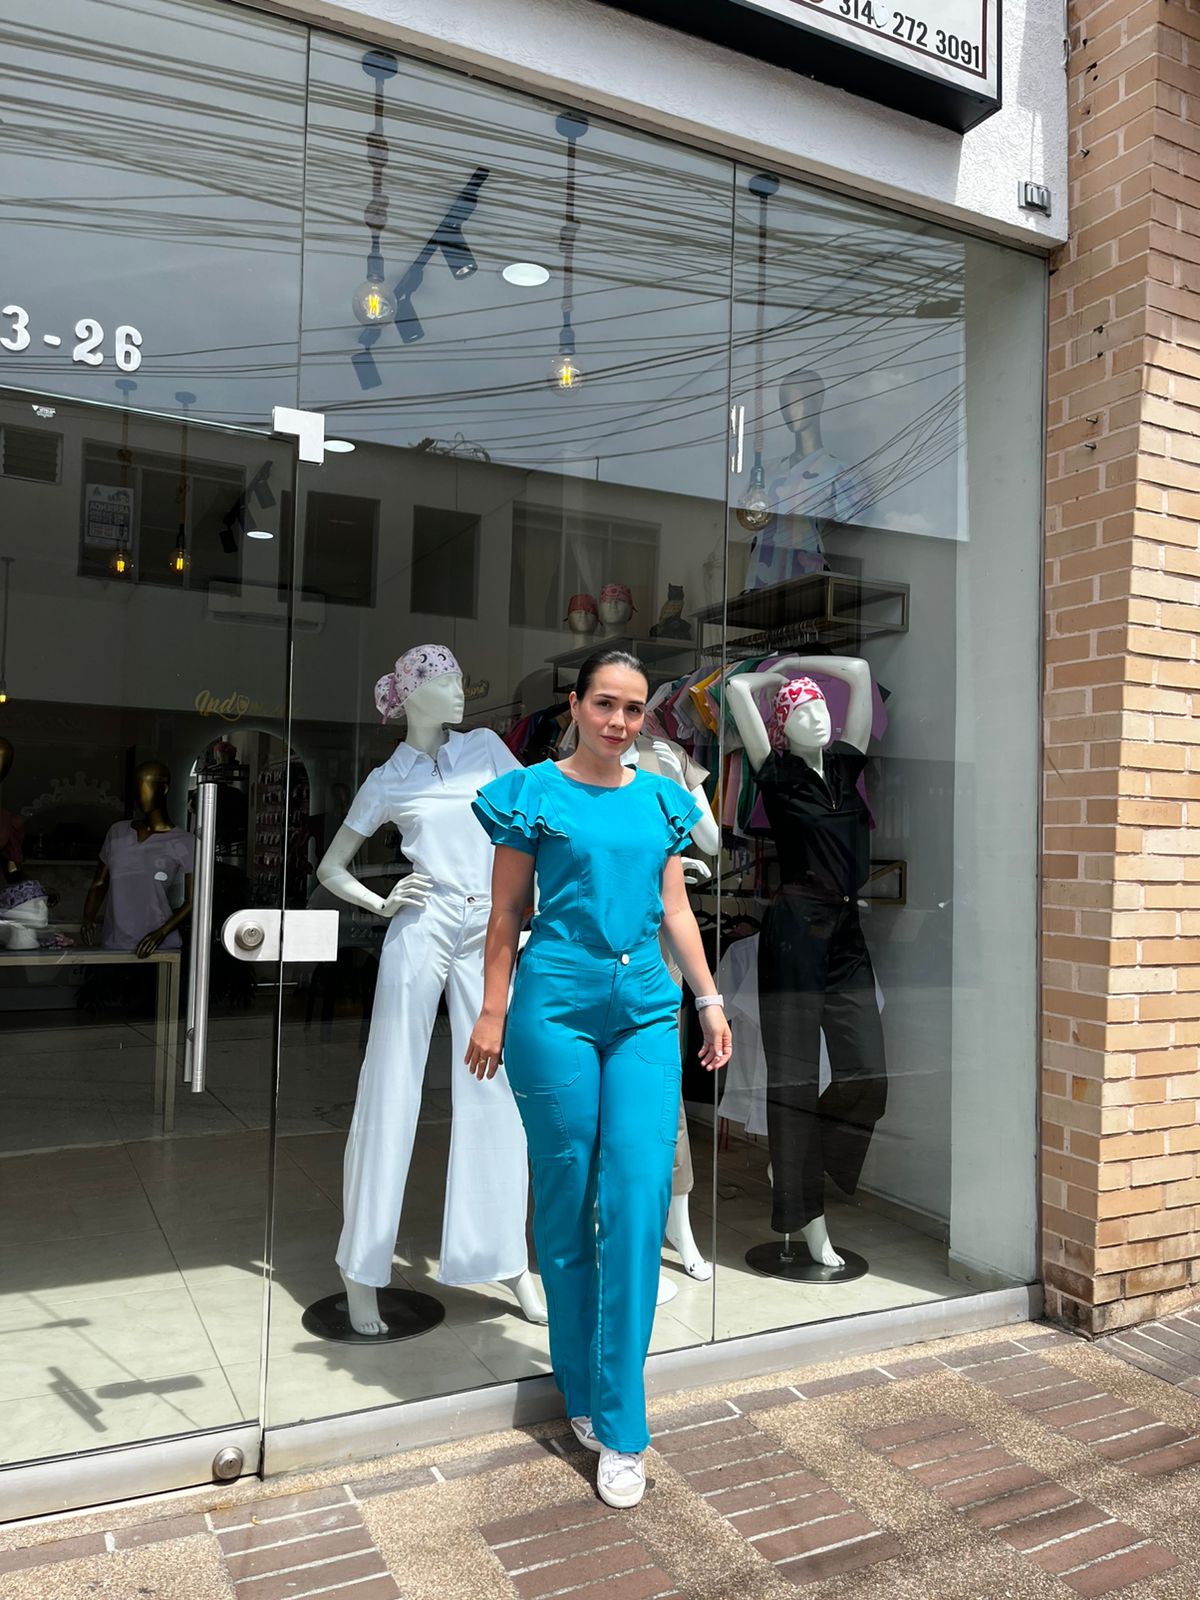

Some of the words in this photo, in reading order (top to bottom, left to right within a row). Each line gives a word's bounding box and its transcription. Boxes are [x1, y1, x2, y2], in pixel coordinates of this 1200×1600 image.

[839, 0, 874, 25] 314
[893, 12, 928, 48] 272
[936, 29, 980, 69] 3091
